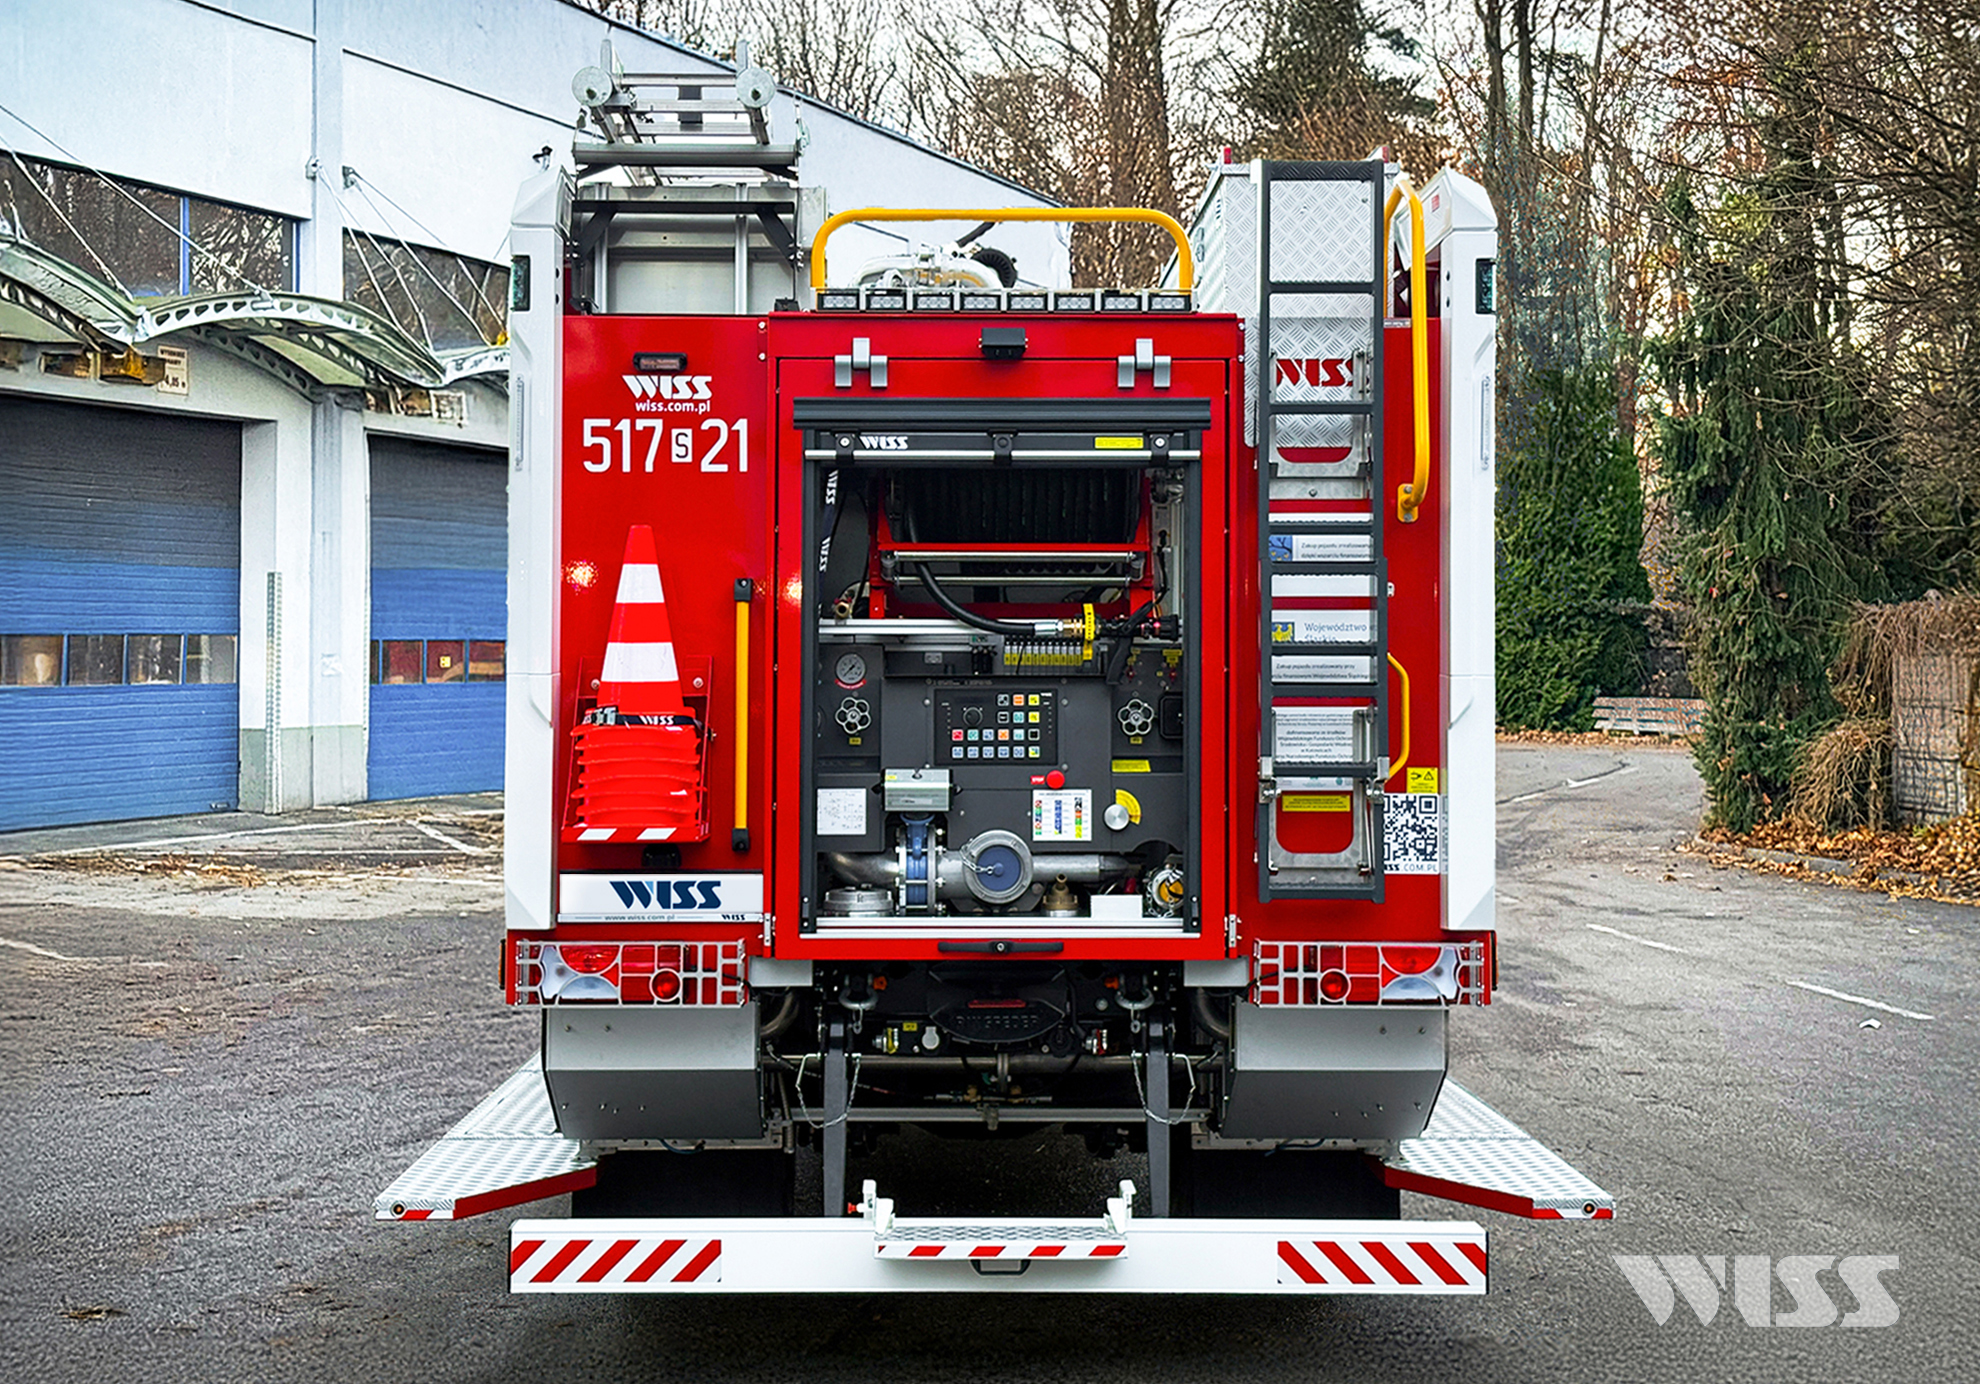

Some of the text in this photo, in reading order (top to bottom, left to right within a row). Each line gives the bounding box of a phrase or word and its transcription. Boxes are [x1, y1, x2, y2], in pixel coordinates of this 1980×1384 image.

[1276, 358, 1354, 387] WIS
[622, 375, 713, 400] WISS
[635, 400, 711, 415] wiss.com.pl
[583, 418, 748, 473] 517 S 21
[859, 435, 908, 450] WISS
[1304, 621, 1368, 634] Województwo
[640, 715, 674, 725] WISS
[1384, 864, 1438, 872] ISS.COM.PL
[609, 881, 722, 909] WISS
